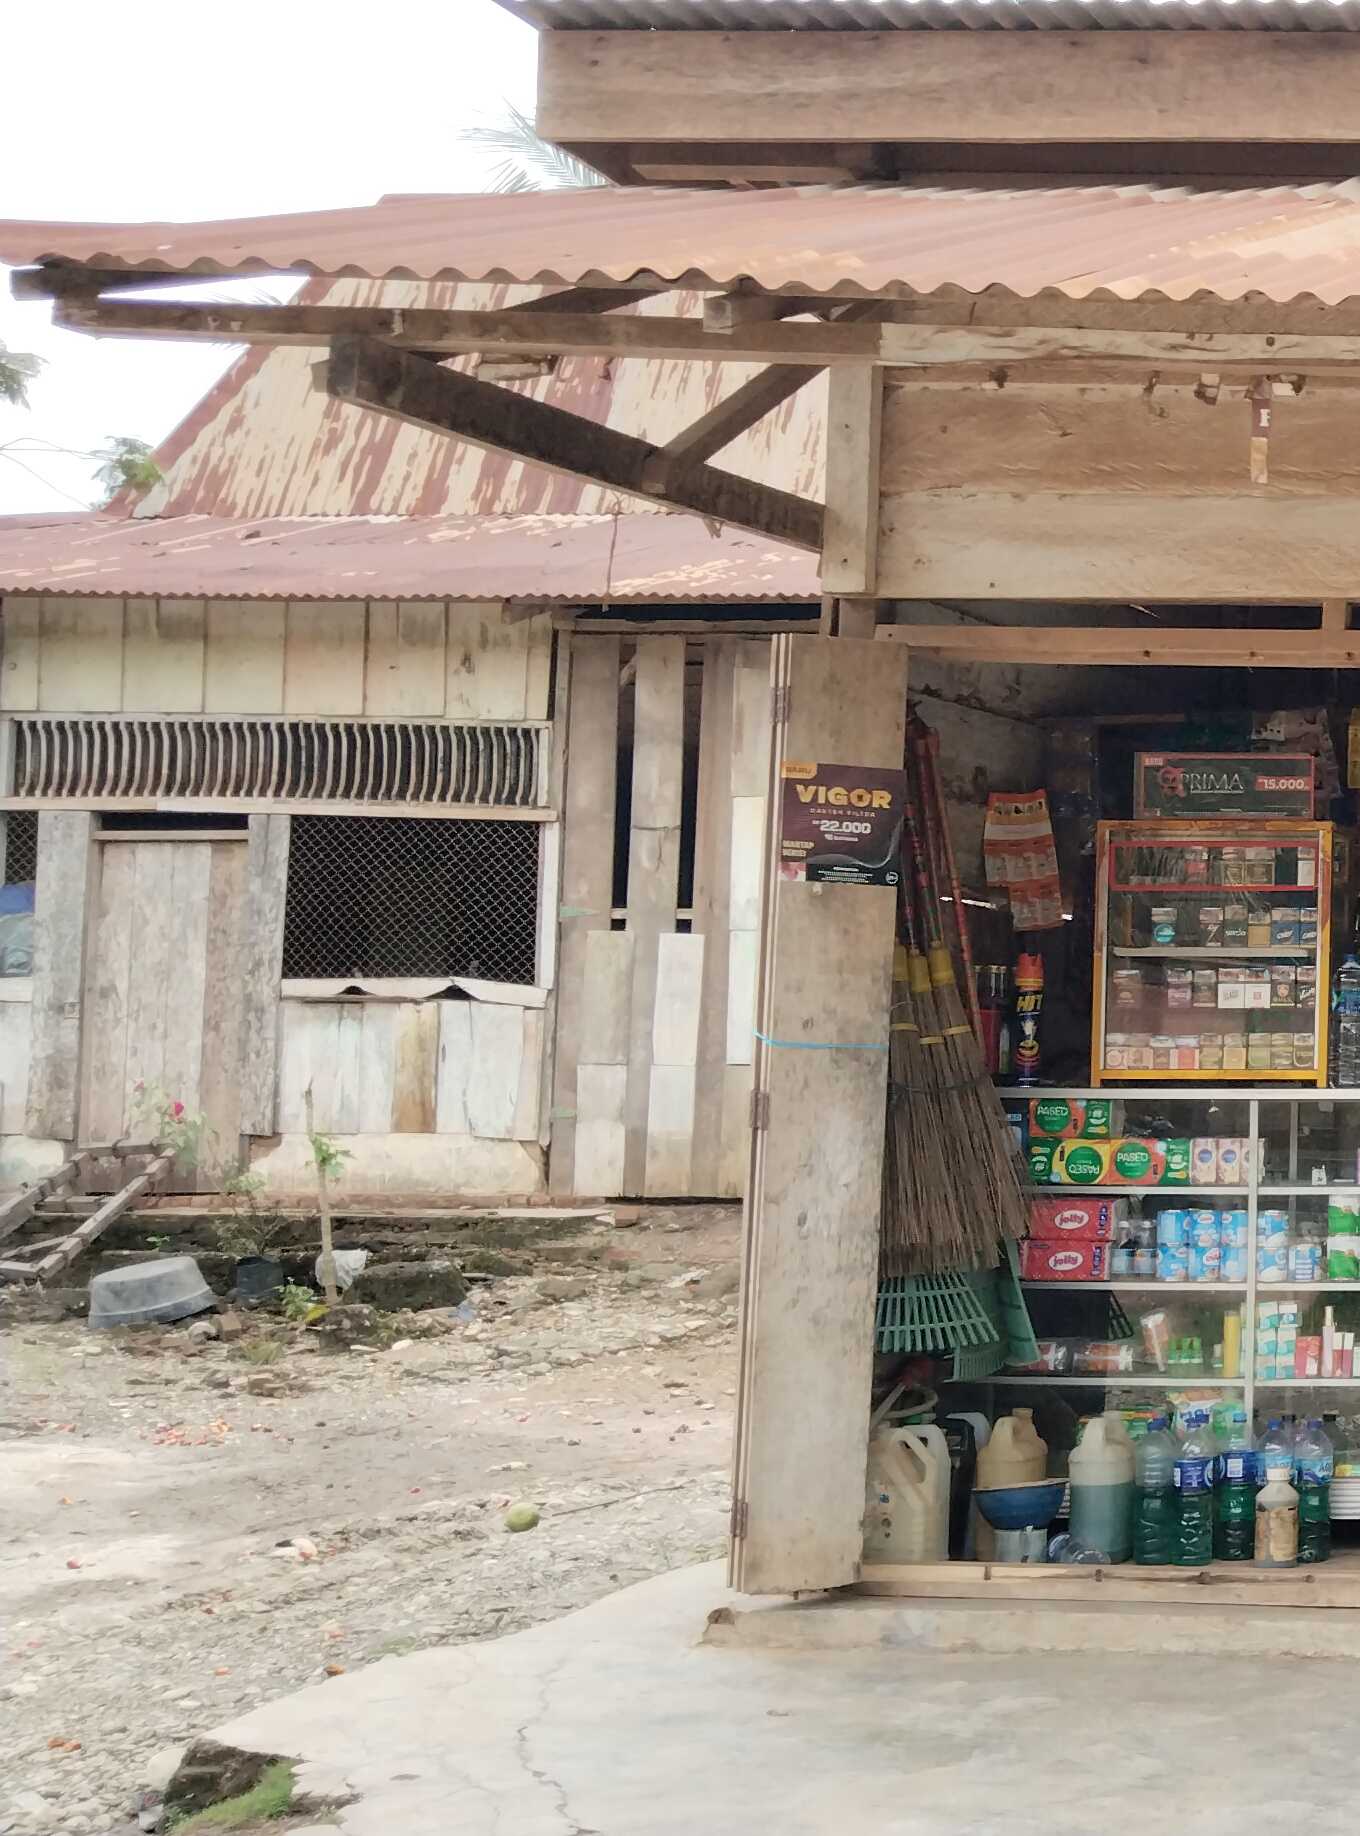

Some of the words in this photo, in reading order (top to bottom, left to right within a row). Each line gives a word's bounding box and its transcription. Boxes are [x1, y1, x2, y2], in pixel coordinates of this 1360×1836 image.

[1180, 772, 1245, 790] PRIMA
[795, 783, 893, 809] VIGOR
[820, 819, 872, 834] 22.000
